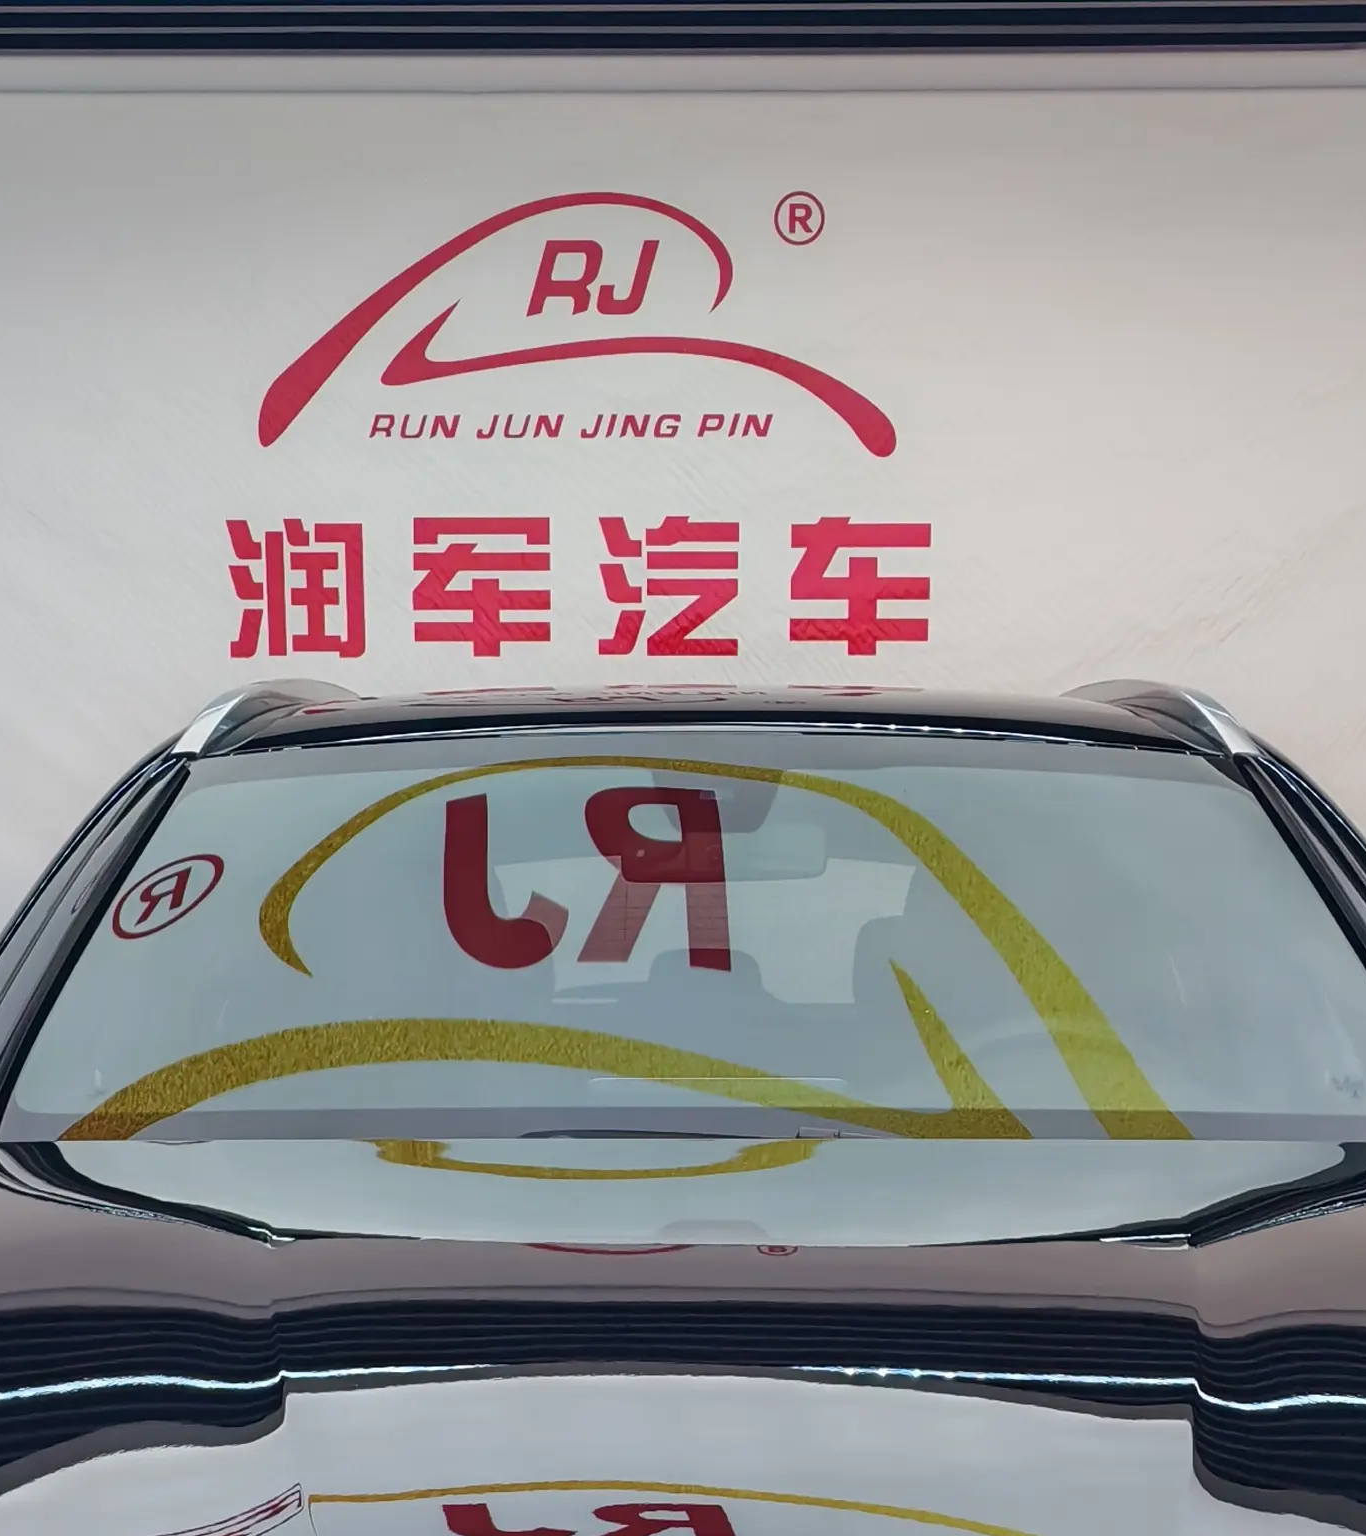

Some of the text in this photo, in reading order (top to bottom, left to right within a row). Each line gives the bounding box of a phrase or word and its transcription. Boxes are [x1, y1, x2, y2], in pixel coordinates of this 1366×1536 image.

[526, 239, 660, 317] RJ
[369, 413, 774, 440] RUN JUN JING PIN
[226, 516, 932, 658] 润军汽车
